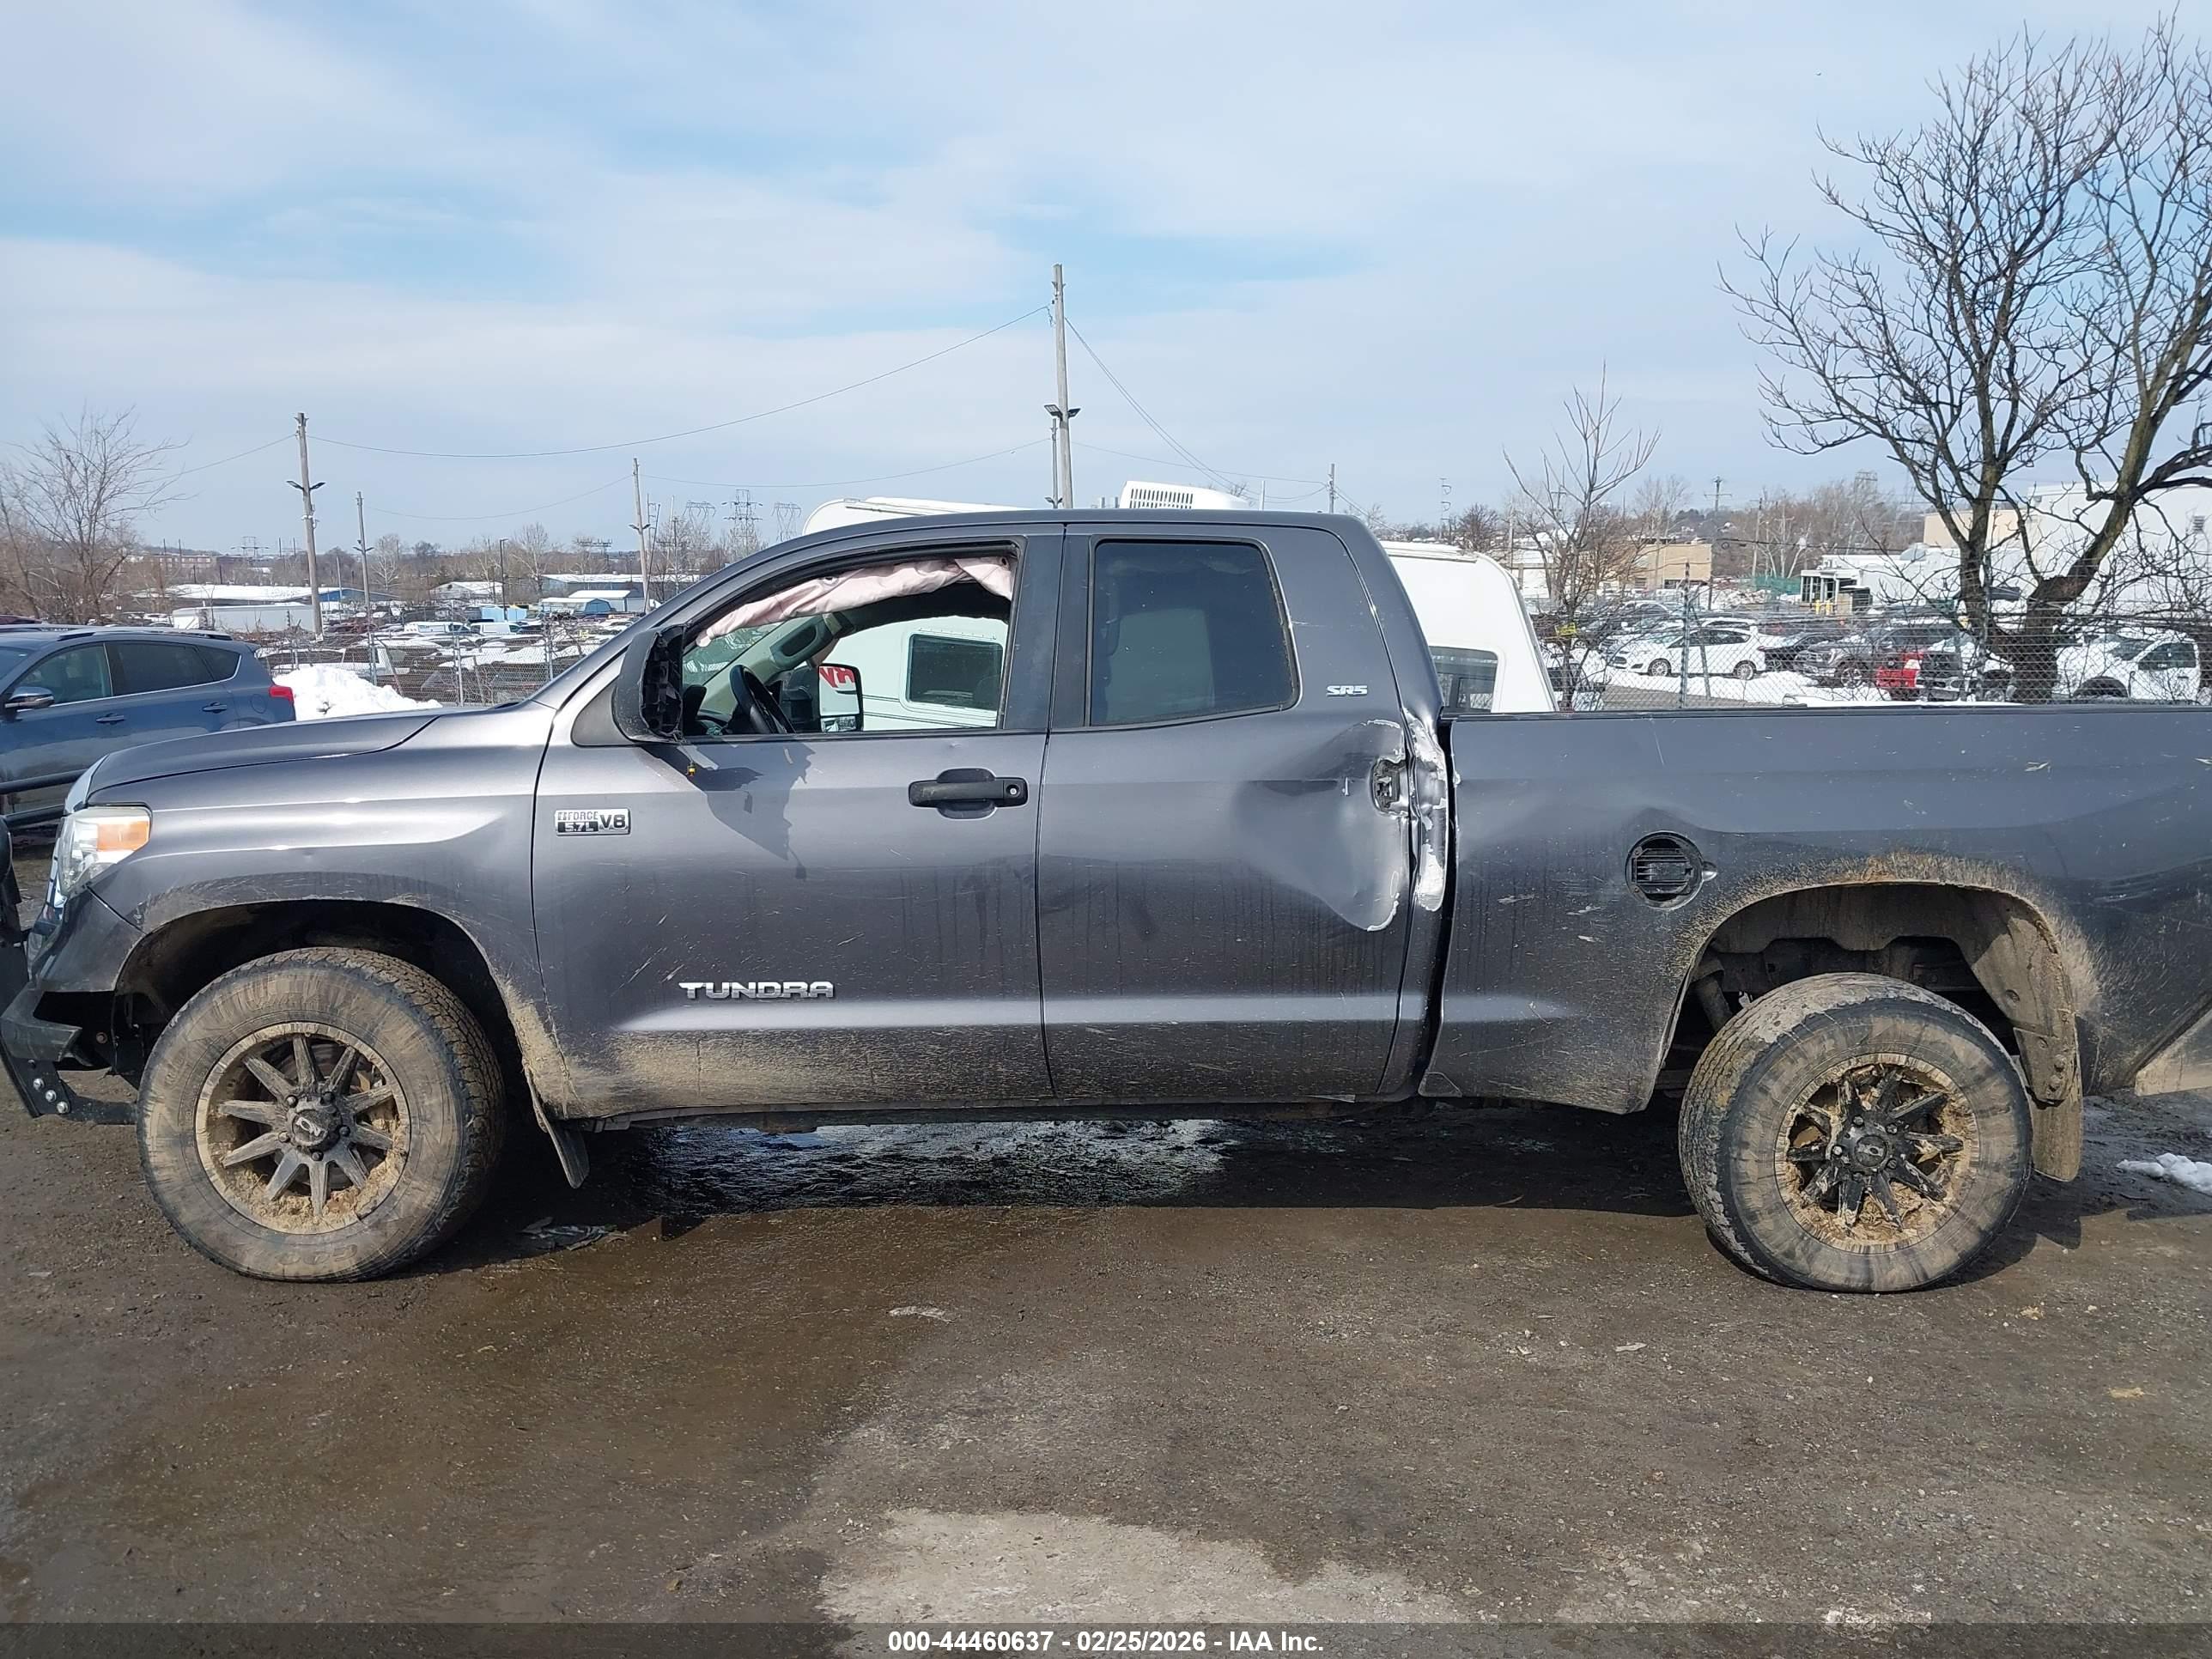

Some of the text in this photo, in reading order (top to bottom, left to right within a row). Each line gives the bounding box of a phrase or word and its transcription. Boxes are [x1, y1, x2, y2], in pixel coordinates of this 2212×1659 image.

[1327, 684, 1368, 696] SR5
[564, 814, 626, 831] 5.7L V8
[678, 981, 834, 999] TUNDRA
